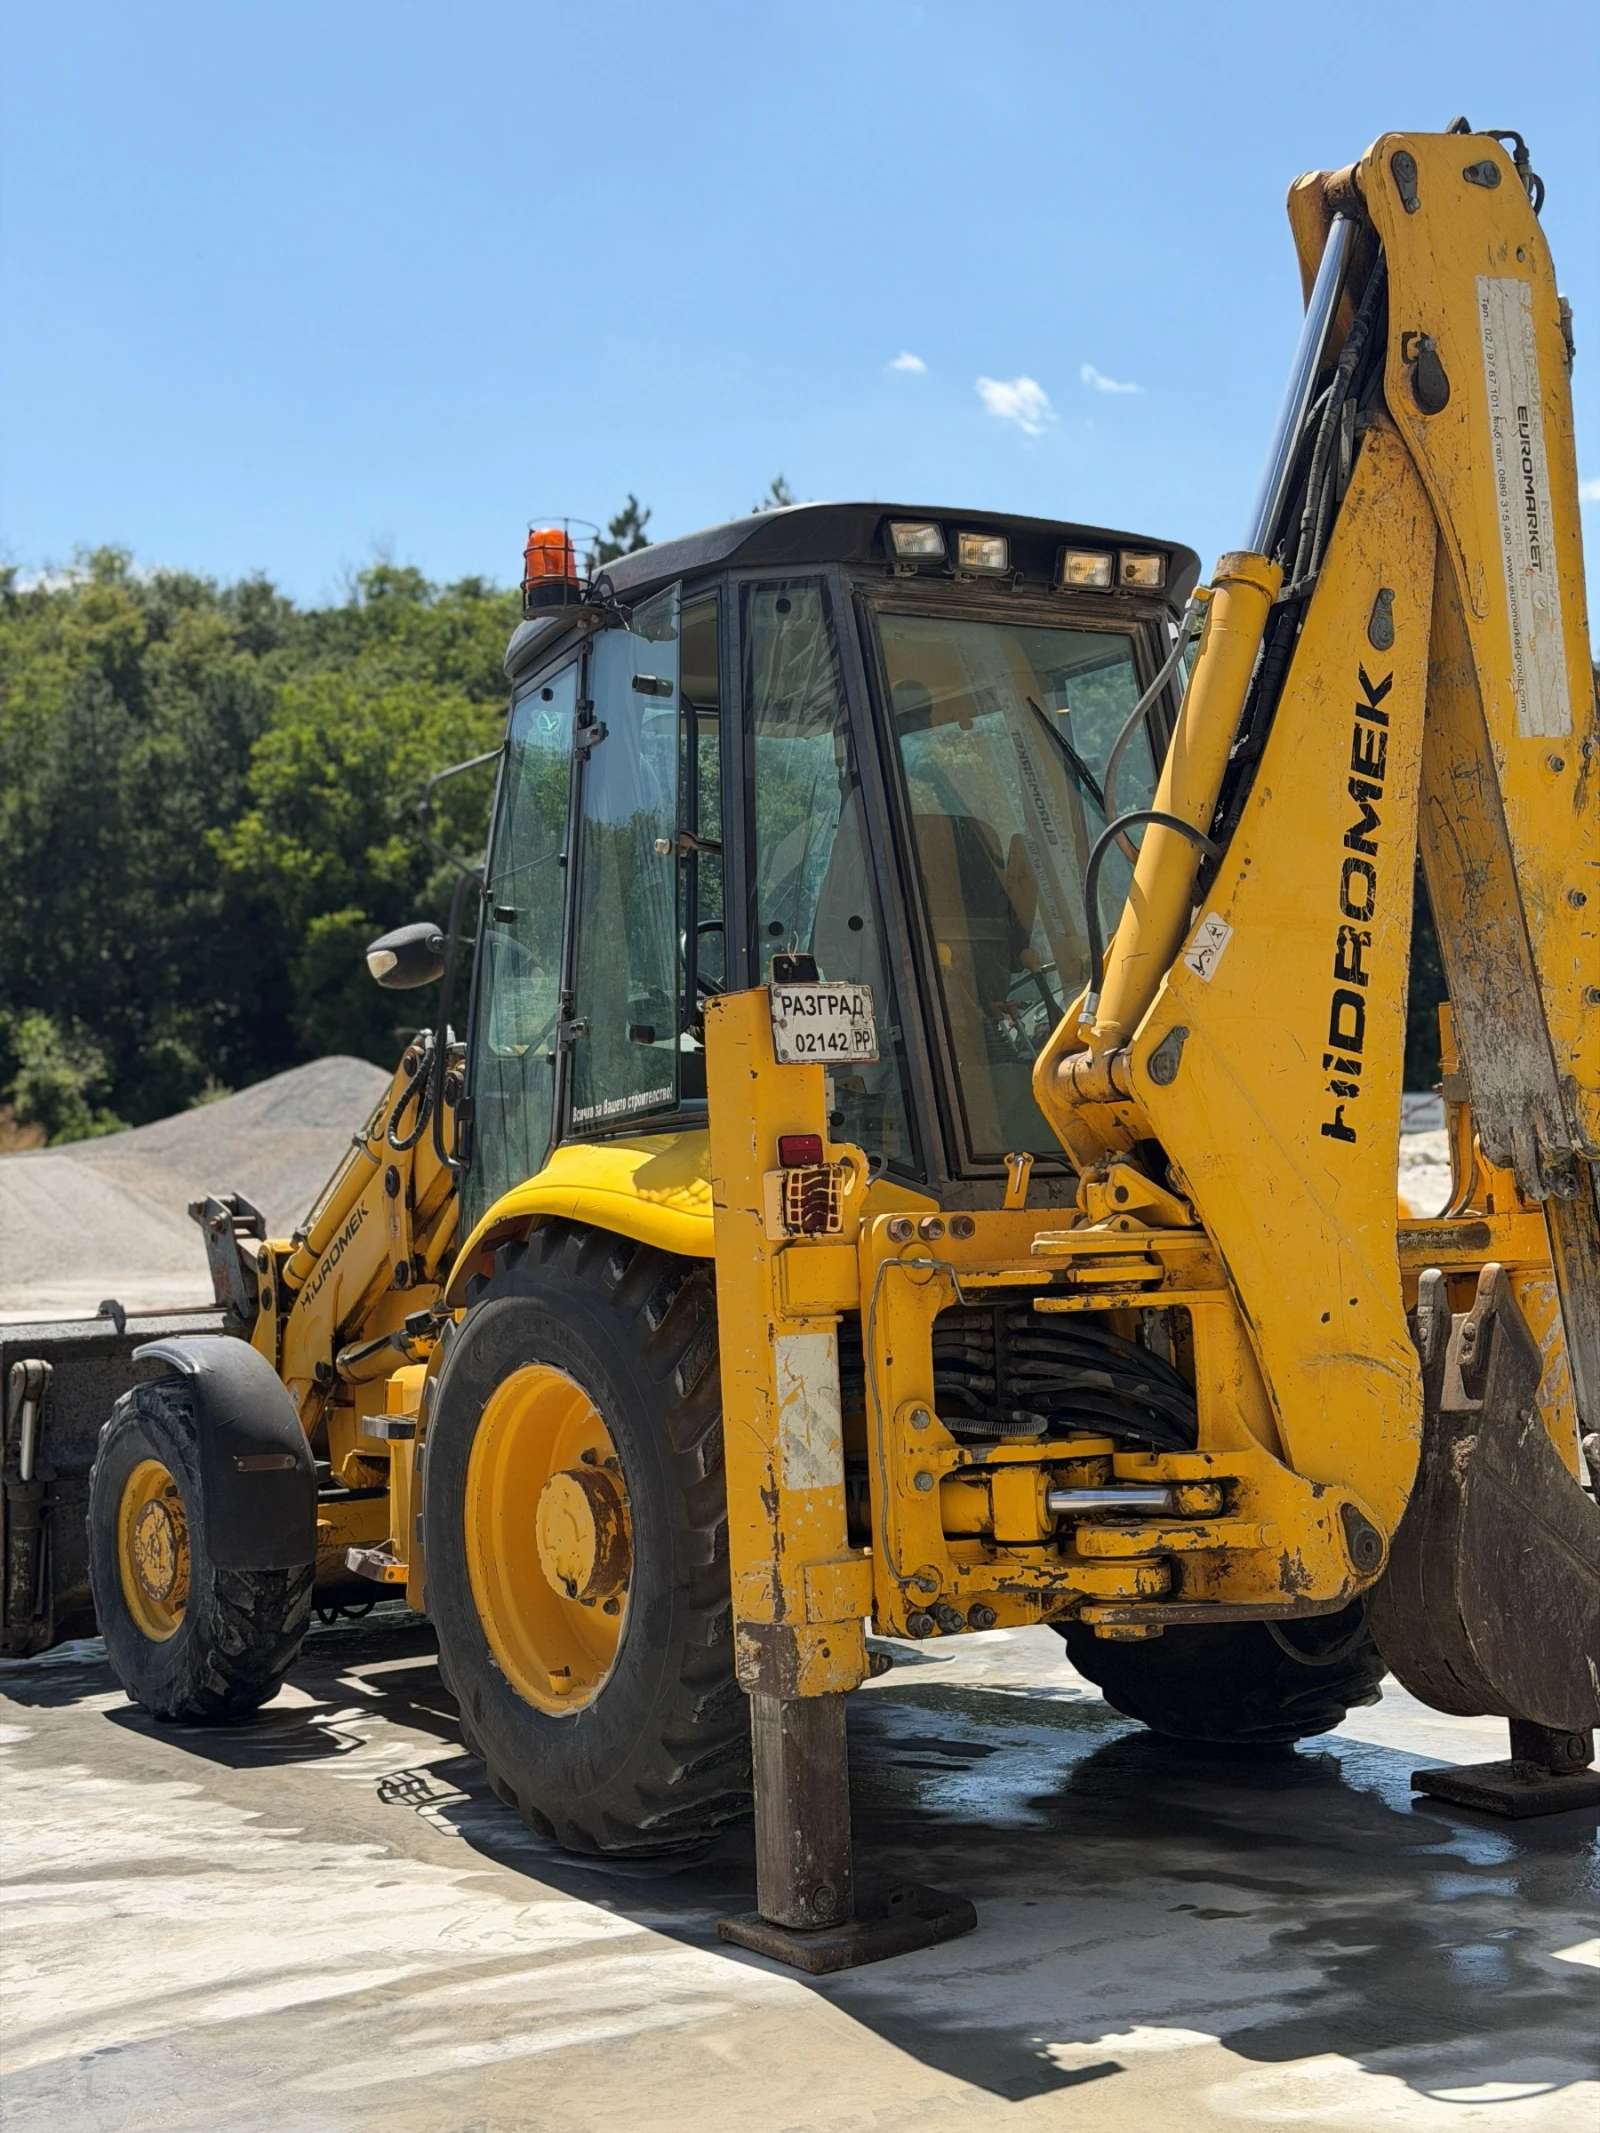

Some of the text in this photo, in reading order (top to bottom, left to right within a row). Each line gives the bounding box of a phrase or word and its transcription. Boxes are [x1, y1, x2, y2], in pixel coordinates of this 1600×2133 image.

[1481, 298, 1491, 325] Тел.:
[1485, 328, 1493, 342] 02
[1487, 353, 1495, 366] 97
[1489, 370, 1497, 384] 67
[1497, 468, 1507, 496] 0889
[1517, 405, 1542, 572] EUROMARKET
[1503, 525, 1512, 545] 490
[781, 995, 864, 1020] РАЗГРАД
[796, 1033, 848, 1052] 02142
[573, 1107, 594, 1122] Всичко
[595, 1105, 602, 1116] за
